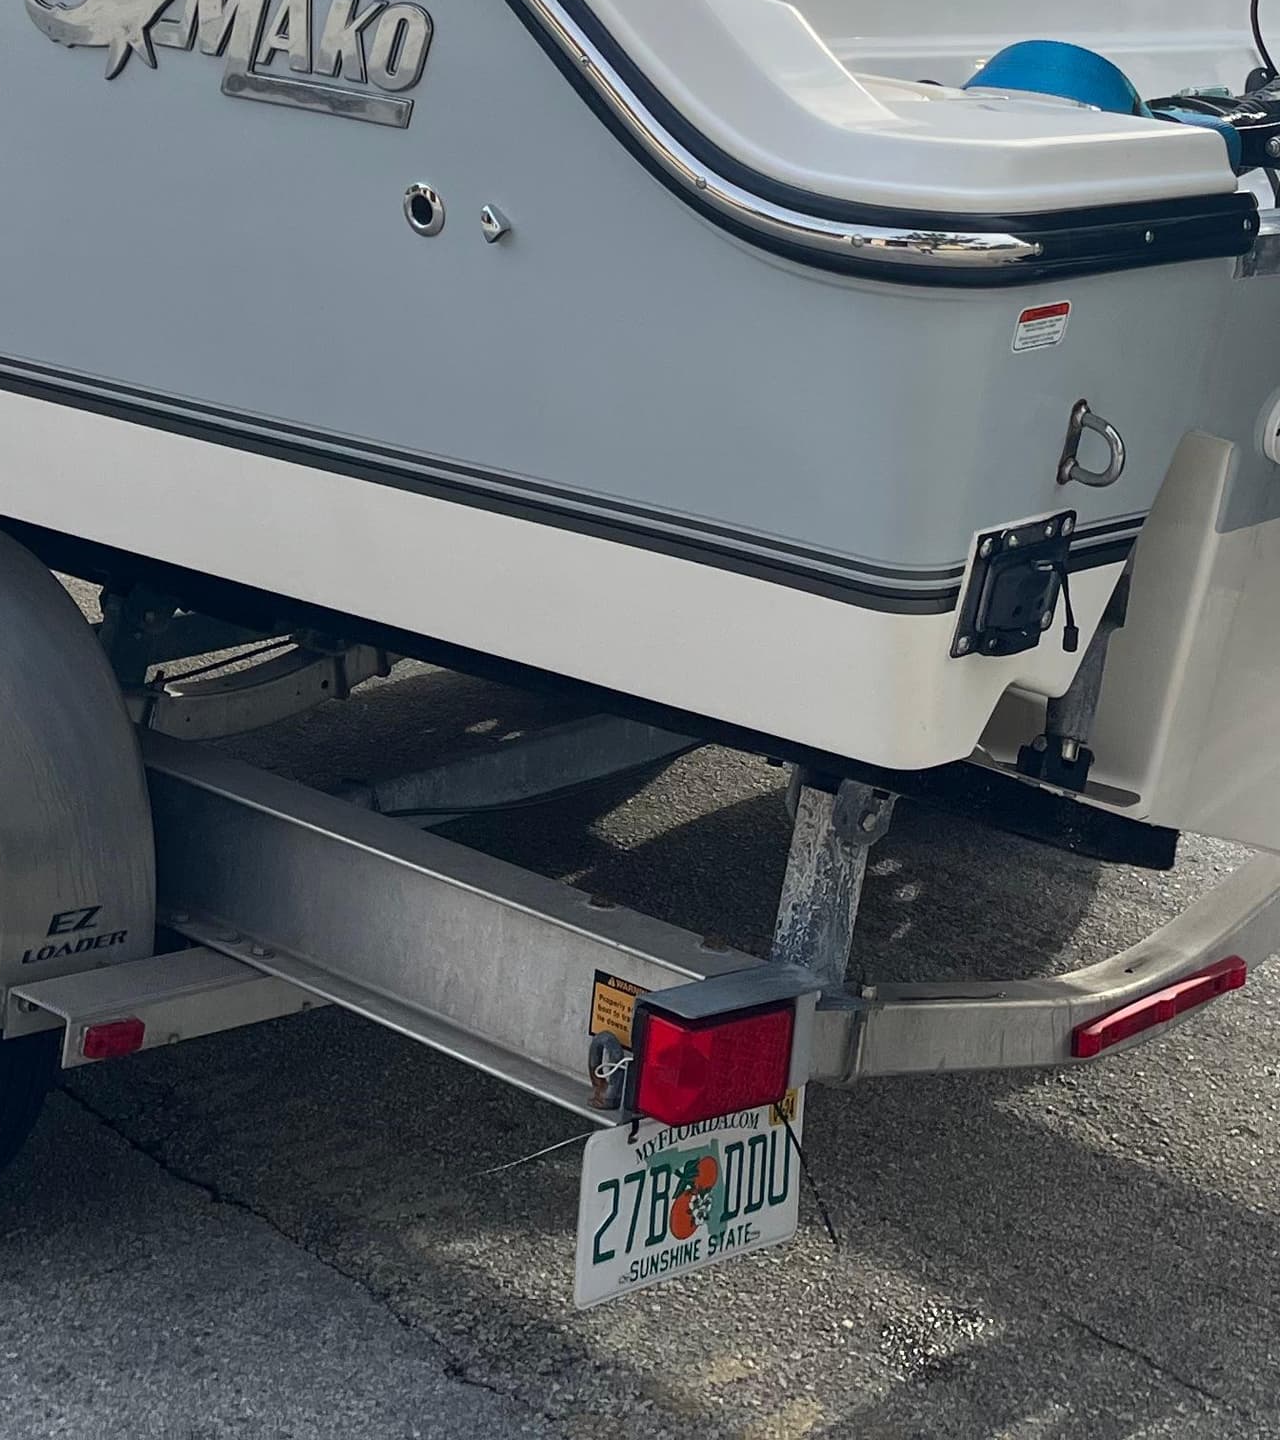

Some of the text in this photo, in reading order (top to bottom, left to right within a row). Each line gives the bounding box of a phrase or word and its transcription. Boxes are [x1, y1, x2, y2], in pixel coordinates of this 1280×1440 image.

[46, 905, 104, 937] EZ
[22, 930, 128, 965] LOADER
[593, 1163, 671, 1265] 27B
[630, 1222, 753, 1282] SUNSHINE STATE
